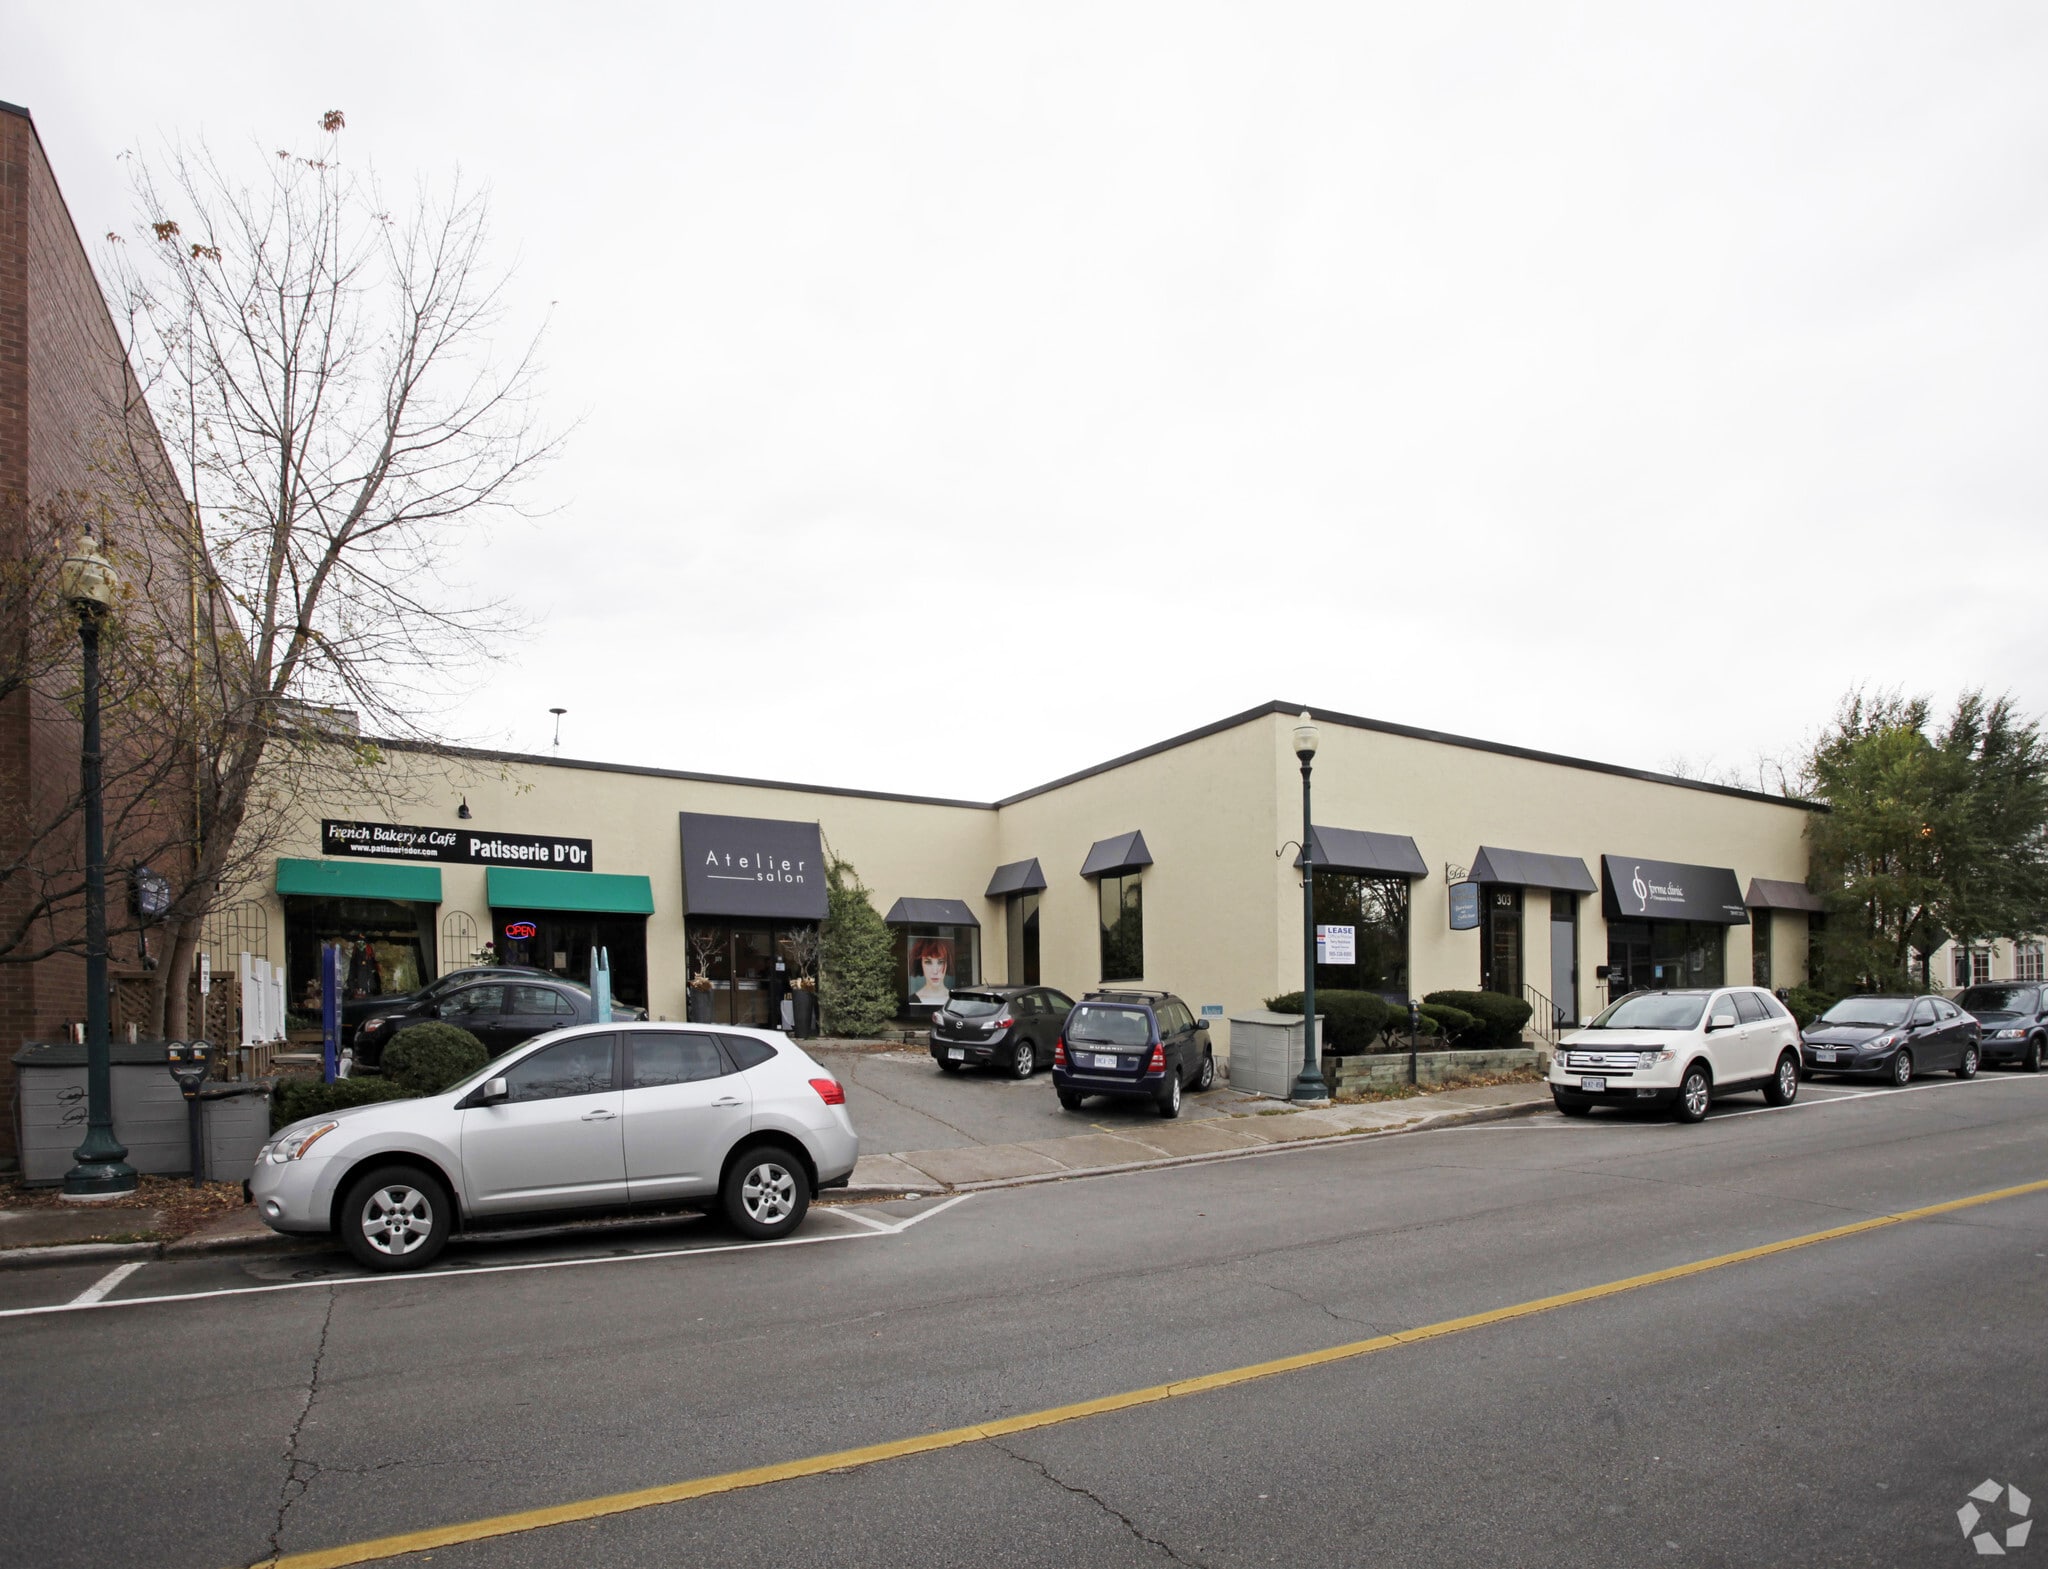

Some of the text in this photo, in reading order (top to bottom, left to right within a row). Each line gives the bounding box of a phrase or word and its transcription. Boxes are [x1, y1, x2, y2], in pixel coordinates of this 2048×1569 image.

[329, 824, 457, 847] French Bakery & Café
[470, 838, 588, 864] Patisserie D'Or
[706, 850, 805, 871] Atelier
[757, 869, 804, 883] salon
[1496, 894, 1512, 906] 303
[505, 924, 536, 937] OPEN
[1328, 927, 1353, 935] LEASE
